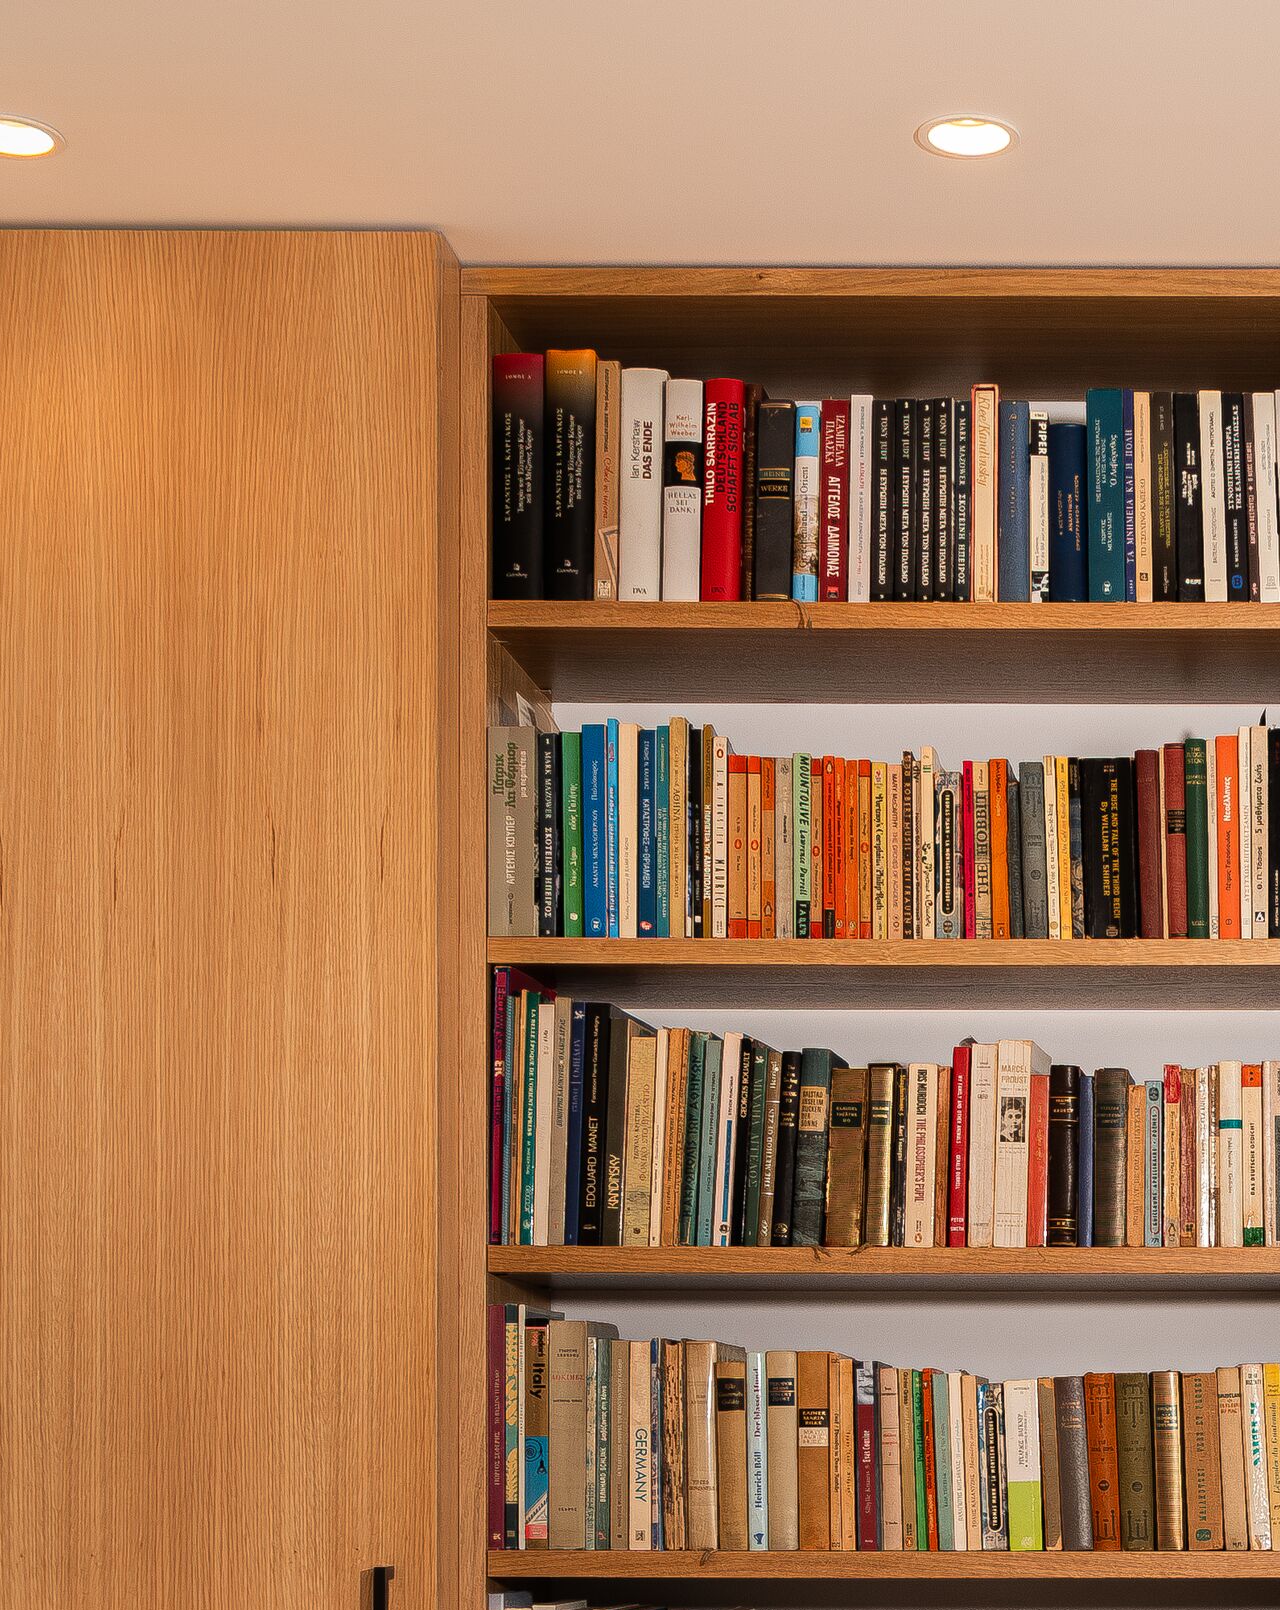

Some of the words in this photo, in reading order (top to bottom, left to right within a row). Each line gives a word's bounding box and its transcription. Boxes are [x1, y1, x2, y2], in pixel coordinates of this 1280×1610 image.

[643, 421, 653, 452] ENDE
[706, 403, 716, 467] SARRAZIN
[717, 402, 728, 493] DEUTSCHLAND
[1038, 423, 1047, 454] PIPER
[643, 456, 652, 480] DAS
[706, 470, 716, 505] THILO
[828, 476, 841, 519] ΑΓΓΕΛΟΣ
[827, 525, 840, 577] ΔΑΙΜΟΝΑΣ
[975, 794, 988, 855] HOBBIT
[1111, 848, 1118, 856] OF
[976, 864, 989, 898] THE
[1001, 1064, 1027, 1072] MARCEL
[1001, 1076, 1027, 1084] PROUST
[588, 1117, 598, 1153] MANET
[586, 1157, 597, 1208] EDOUARD
[607, 1155, 620, 1209] KANDINSKY
[537, 1331, 545, 1356] Fodor's
[530, 1363, 546, 1398] Italy
[635, 1428, 647, 1501] GERMANY
